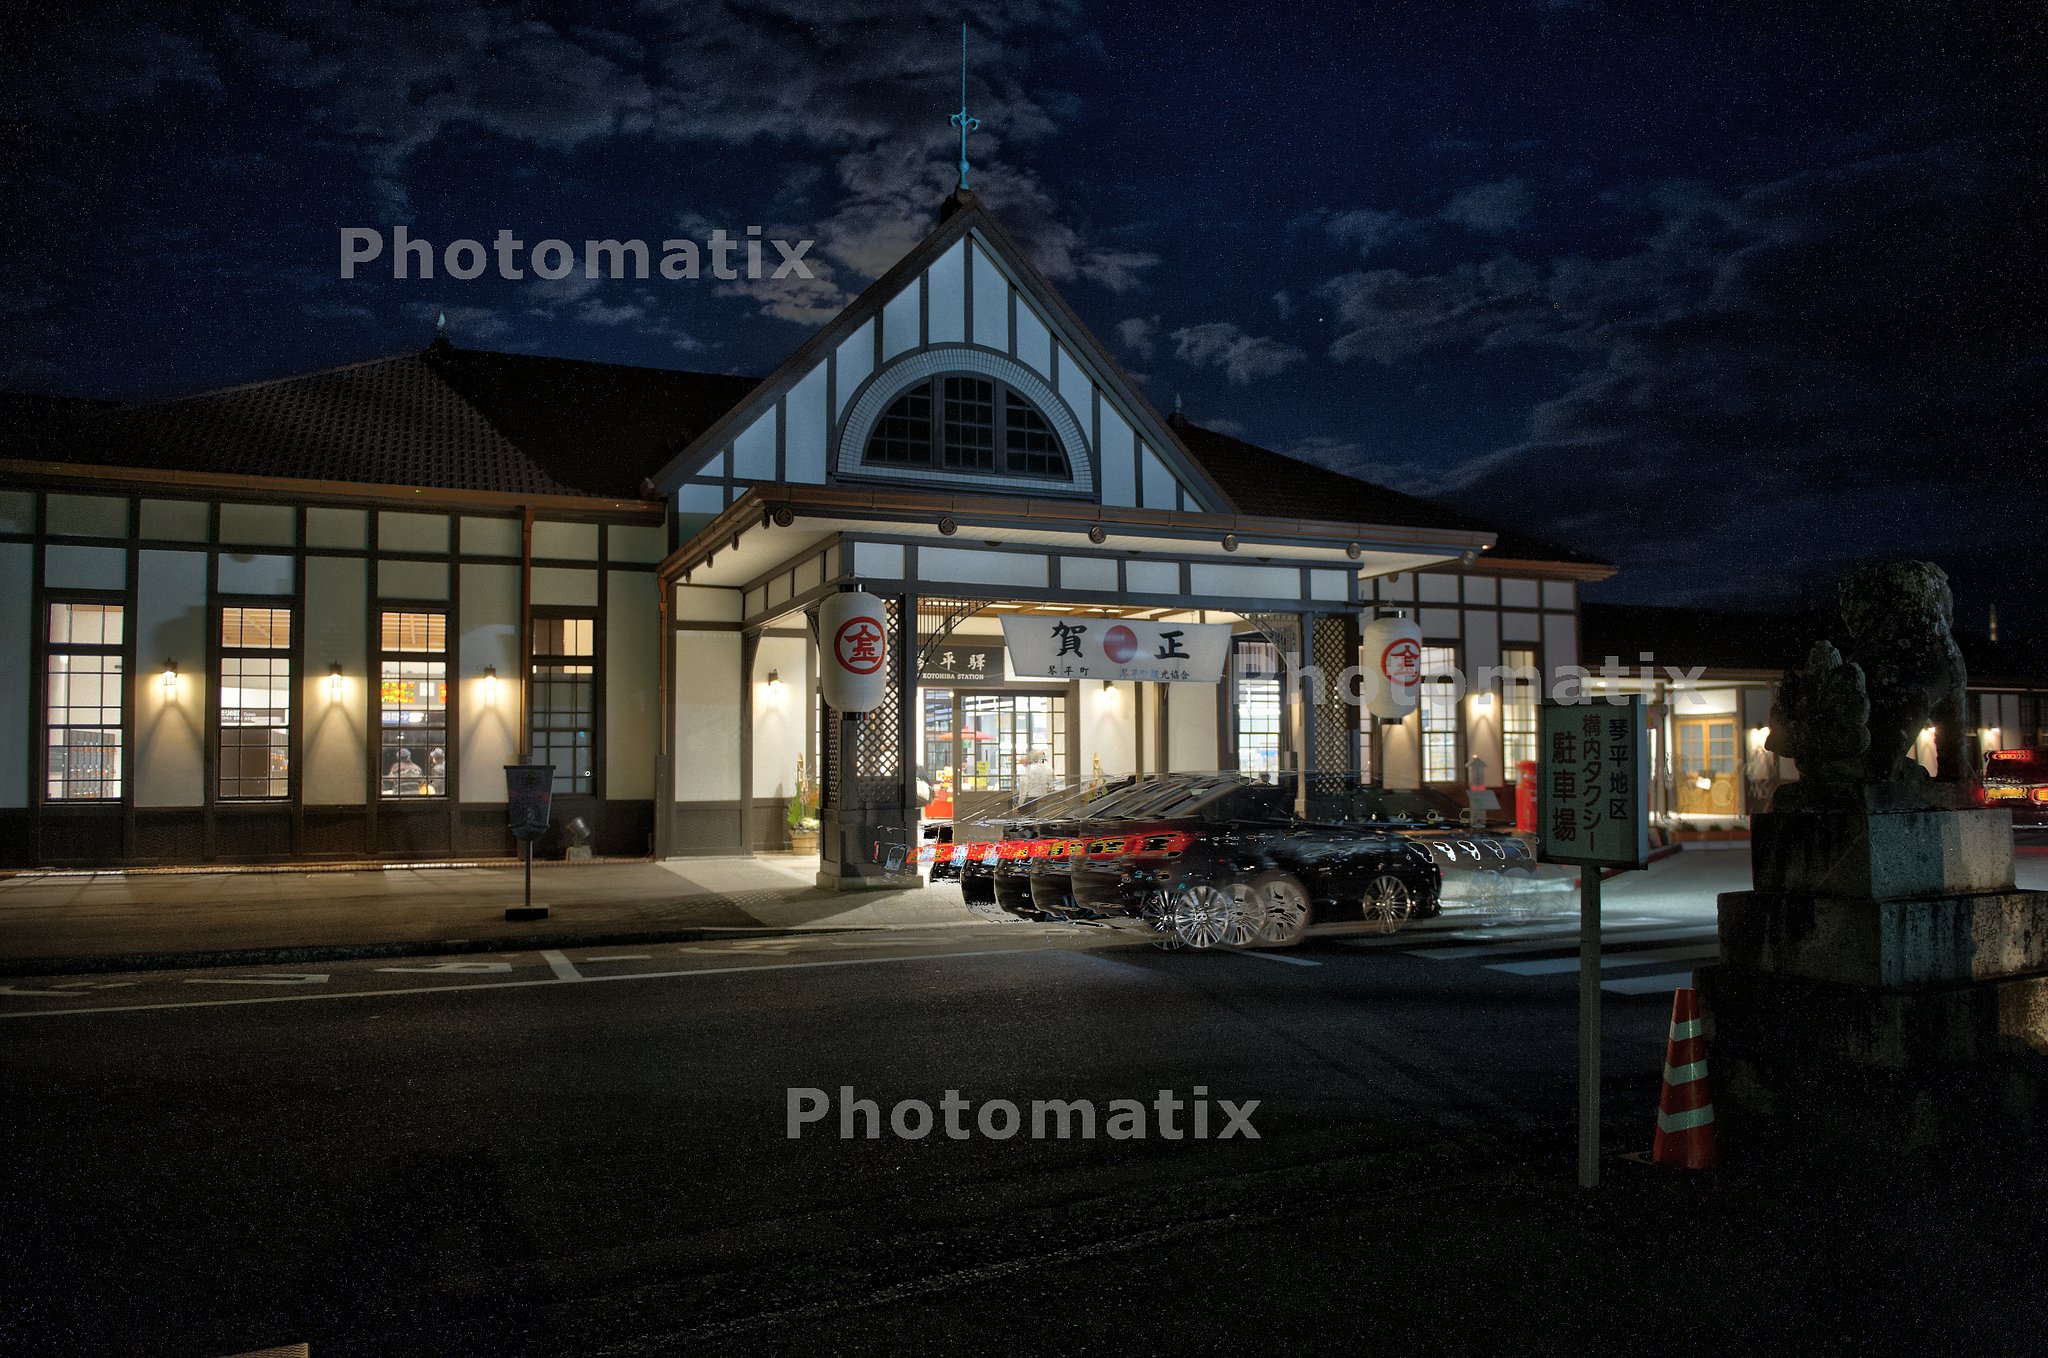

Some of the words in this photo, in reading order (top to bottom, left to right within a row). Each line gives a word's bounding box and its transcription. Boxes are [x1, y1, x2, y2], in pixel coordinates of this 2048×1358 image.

[1050, 621, 1088, 658] 賀
[1154, 630, 1190, 660] 正
[922, 672, 955, 680] KOTOHIRA
[1552, 730, 1577, 842] 駐車場
[1608, 718, 1628, 820] 琴平地区
